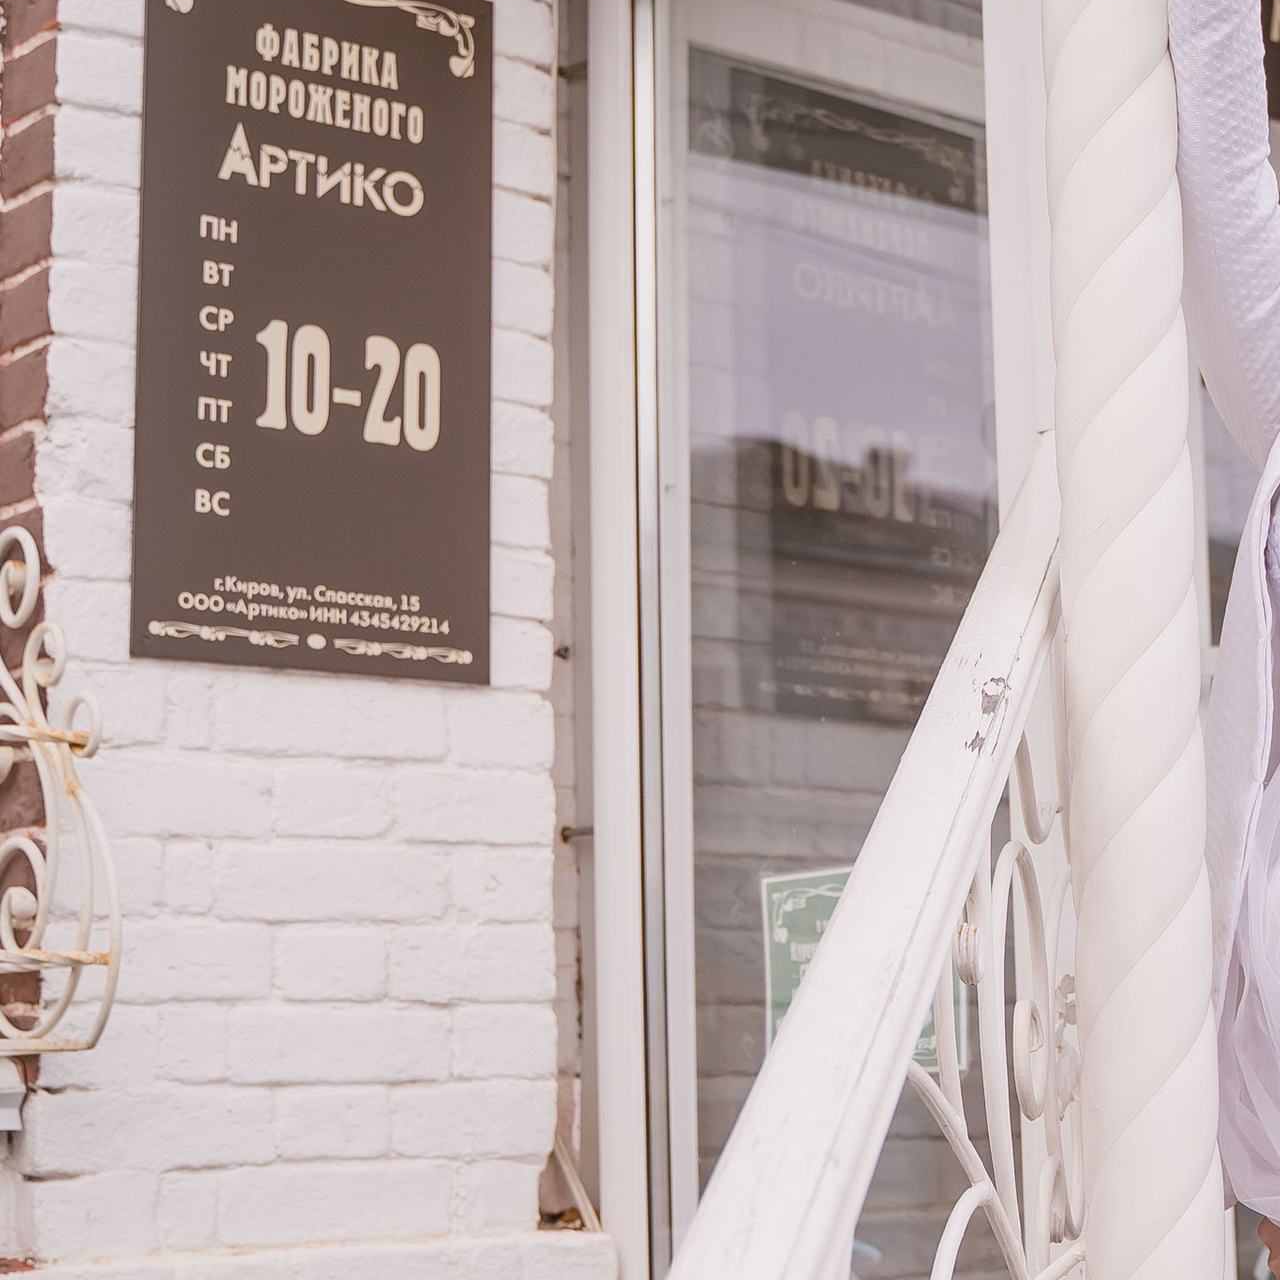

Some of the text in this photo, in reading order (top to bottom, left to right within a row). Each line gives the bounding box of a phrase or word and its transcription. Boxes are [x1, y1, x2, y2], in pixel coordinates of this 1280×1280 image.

[255, 23, 398, 90] ФАБРИКА
[225, 65, 424, 144] МОРОЖЕНОГО
[200, 214, 238, 243] ПН
[202, 260, 235, 287] ВТ
[199, 305, 235, 332] СР
[200, 351, 233, 378] ЧТ
[255, 319, 441, 452] 10-20
[198, 396, 233, 423] ПТ
[195, 442, 232, 469] СБ
[194, 488, 231, 516] ВС
[286, 585, 312, 604] ул.
[313, 584, 398, 612] Спасская,
[400, 594, 421, 612] 15
[178, 591, 225, 613] ООО
[309, 605, 348, 625] ИНН
[350, 610, 451, 636] 4345429214
